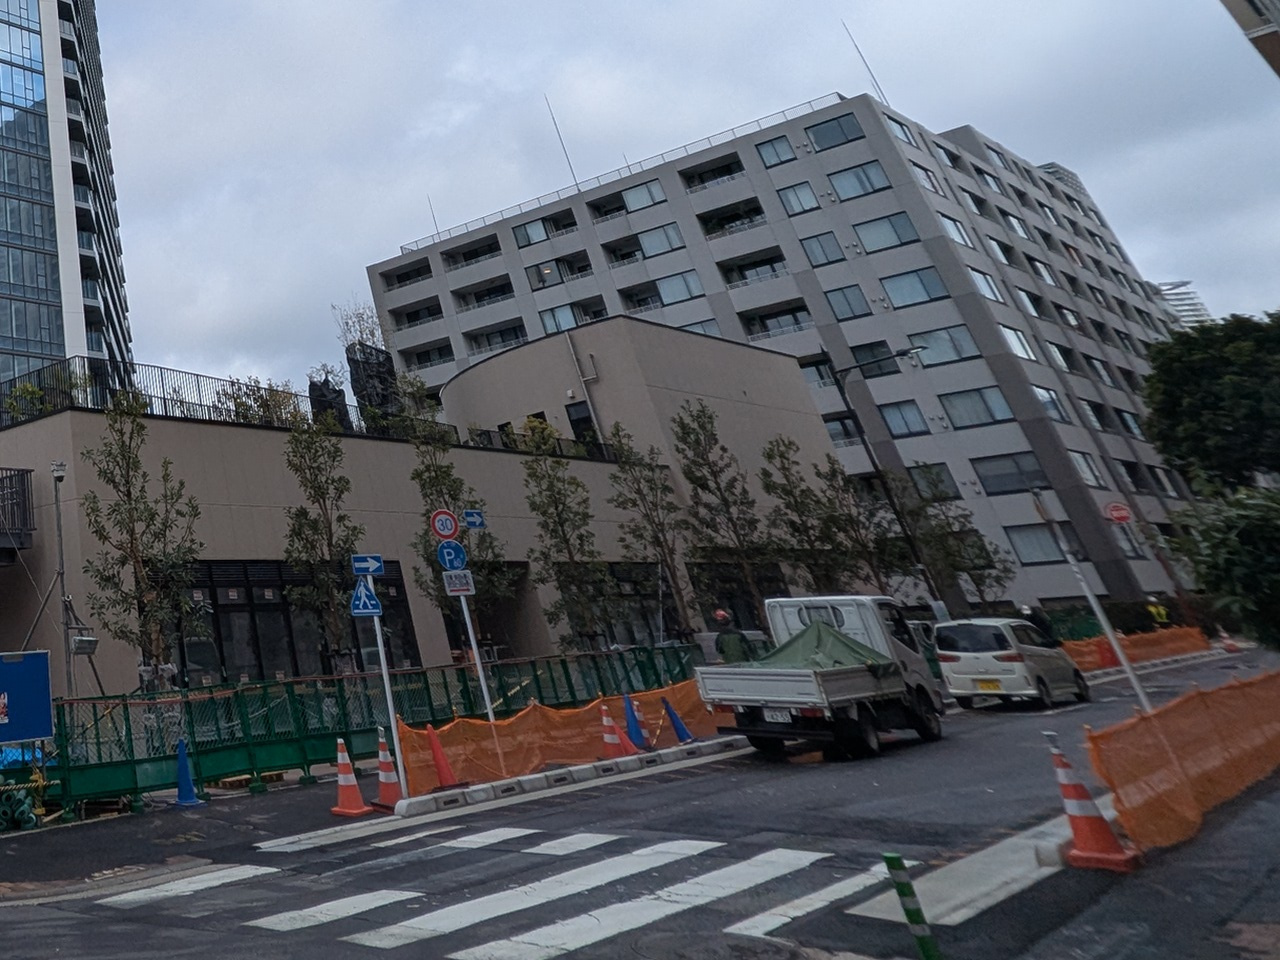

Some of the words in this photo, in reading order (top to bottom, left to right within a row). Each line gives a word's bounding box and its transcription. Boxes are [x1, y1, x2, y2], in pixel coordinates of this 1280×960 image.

[437, 518, 453, 532] 30
[443, 549, 455, 568] P
[453, 558, 462, 568] 60
